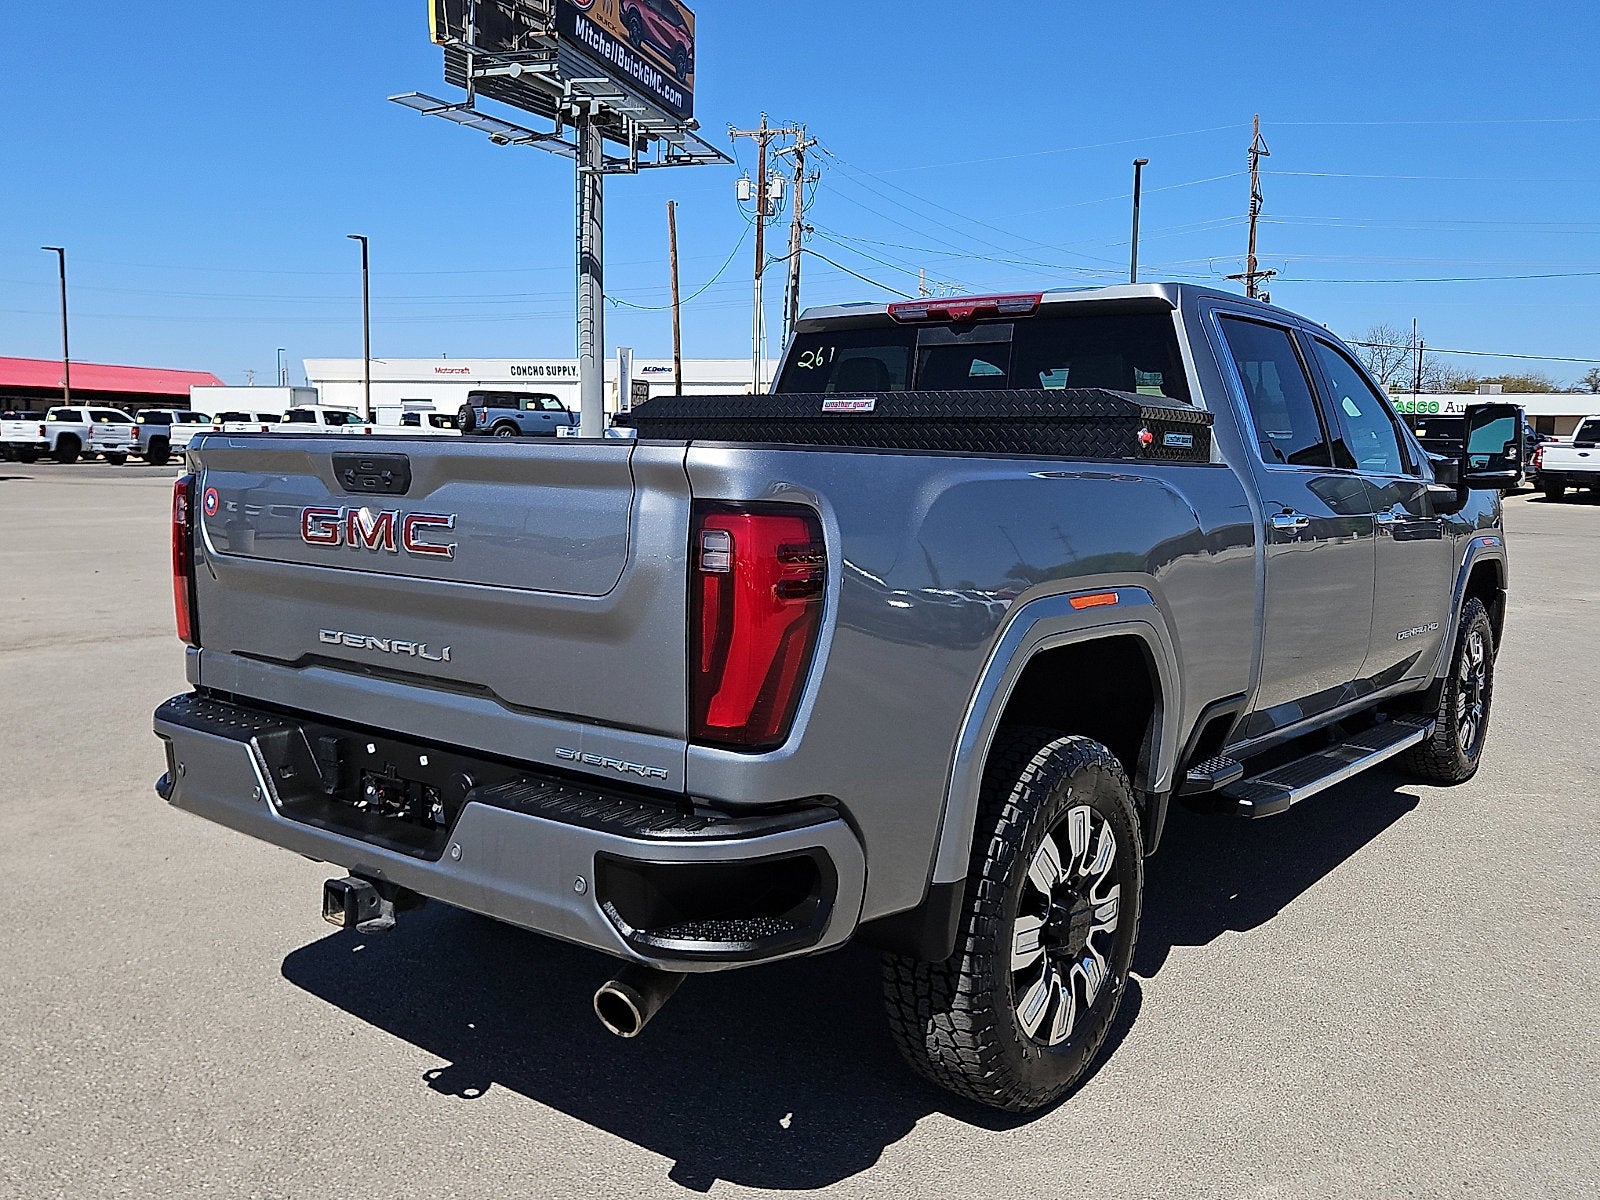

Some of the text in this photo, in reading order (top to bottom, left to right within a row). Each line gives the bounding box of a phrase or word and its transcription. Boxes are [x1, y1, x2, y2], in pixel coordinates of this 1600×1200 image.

[596, 12, 618, 34] BUICK
[575, 14, 683, 108] MitchellBuickGMC.com
[434, 366, 471, 375] Motorcraft
[510, 365, 545, 376] CONCHO
[1391, 396, 1440, 414] ASCO
[301, 505, 457, 559] GMC
[1396, 621, 1440, 641] DENALI HD
[318, 628, 451, 662] DENALI
[554, 747, 669, 780] SIERRA
